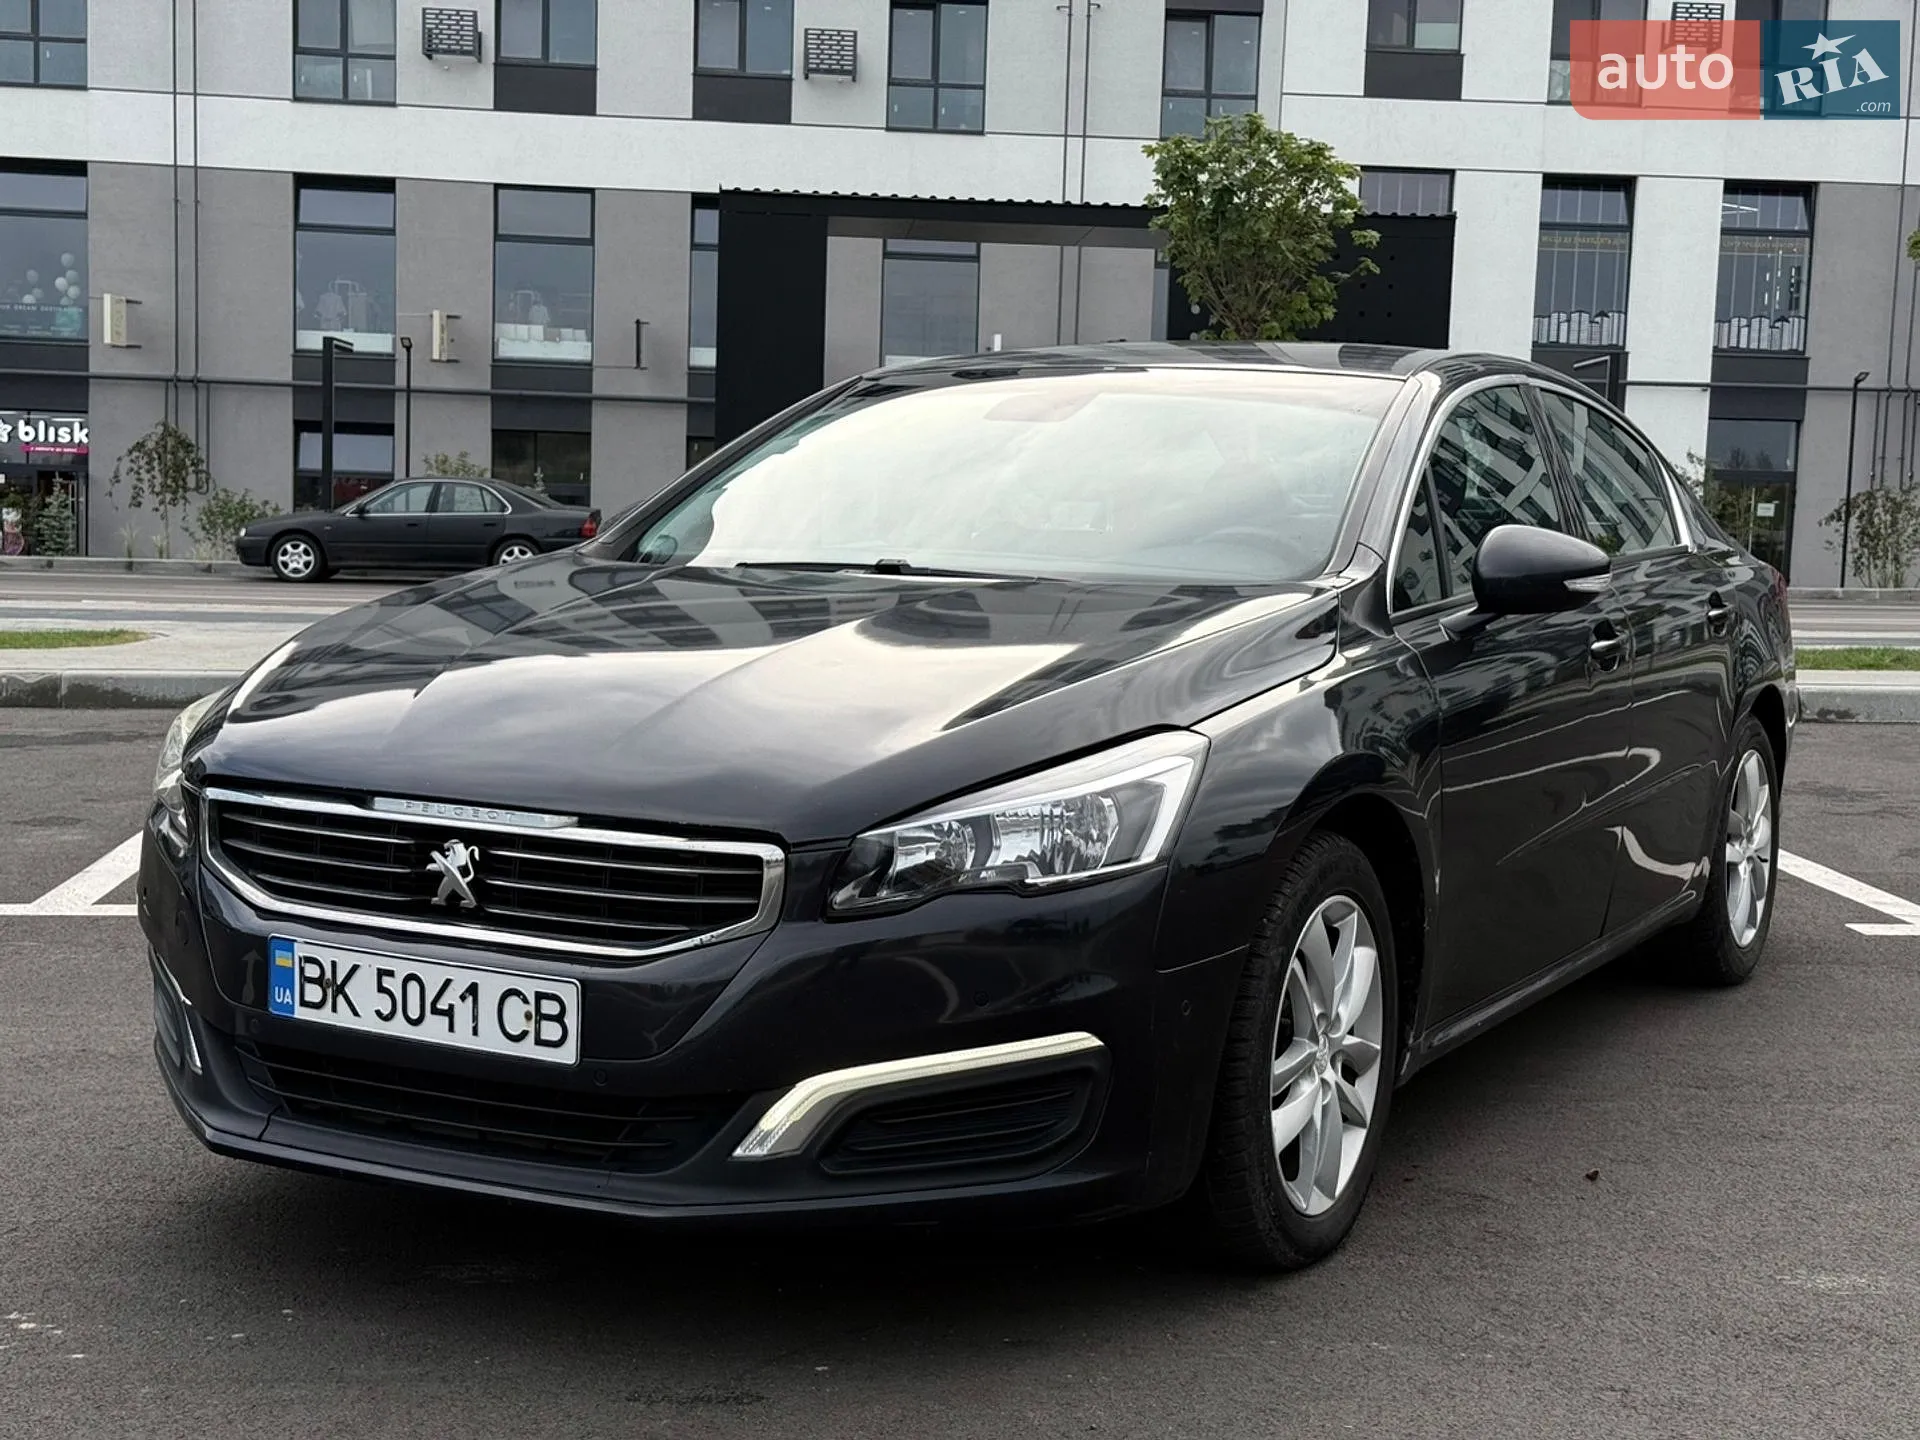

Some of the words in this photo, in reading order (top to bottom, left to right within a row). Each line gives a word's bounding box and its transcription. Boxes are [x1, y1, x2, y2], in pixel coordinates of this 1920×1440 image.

[18, 419, 89, 444] blisk
[403, 799, 517, 824] PEUGEOT
[274, 985, 294, 1006] UA
[299, 955, 362, 1018] BK
[373, 966, 481, 1037] 5041
[496, 986, 569, 1049] CB
